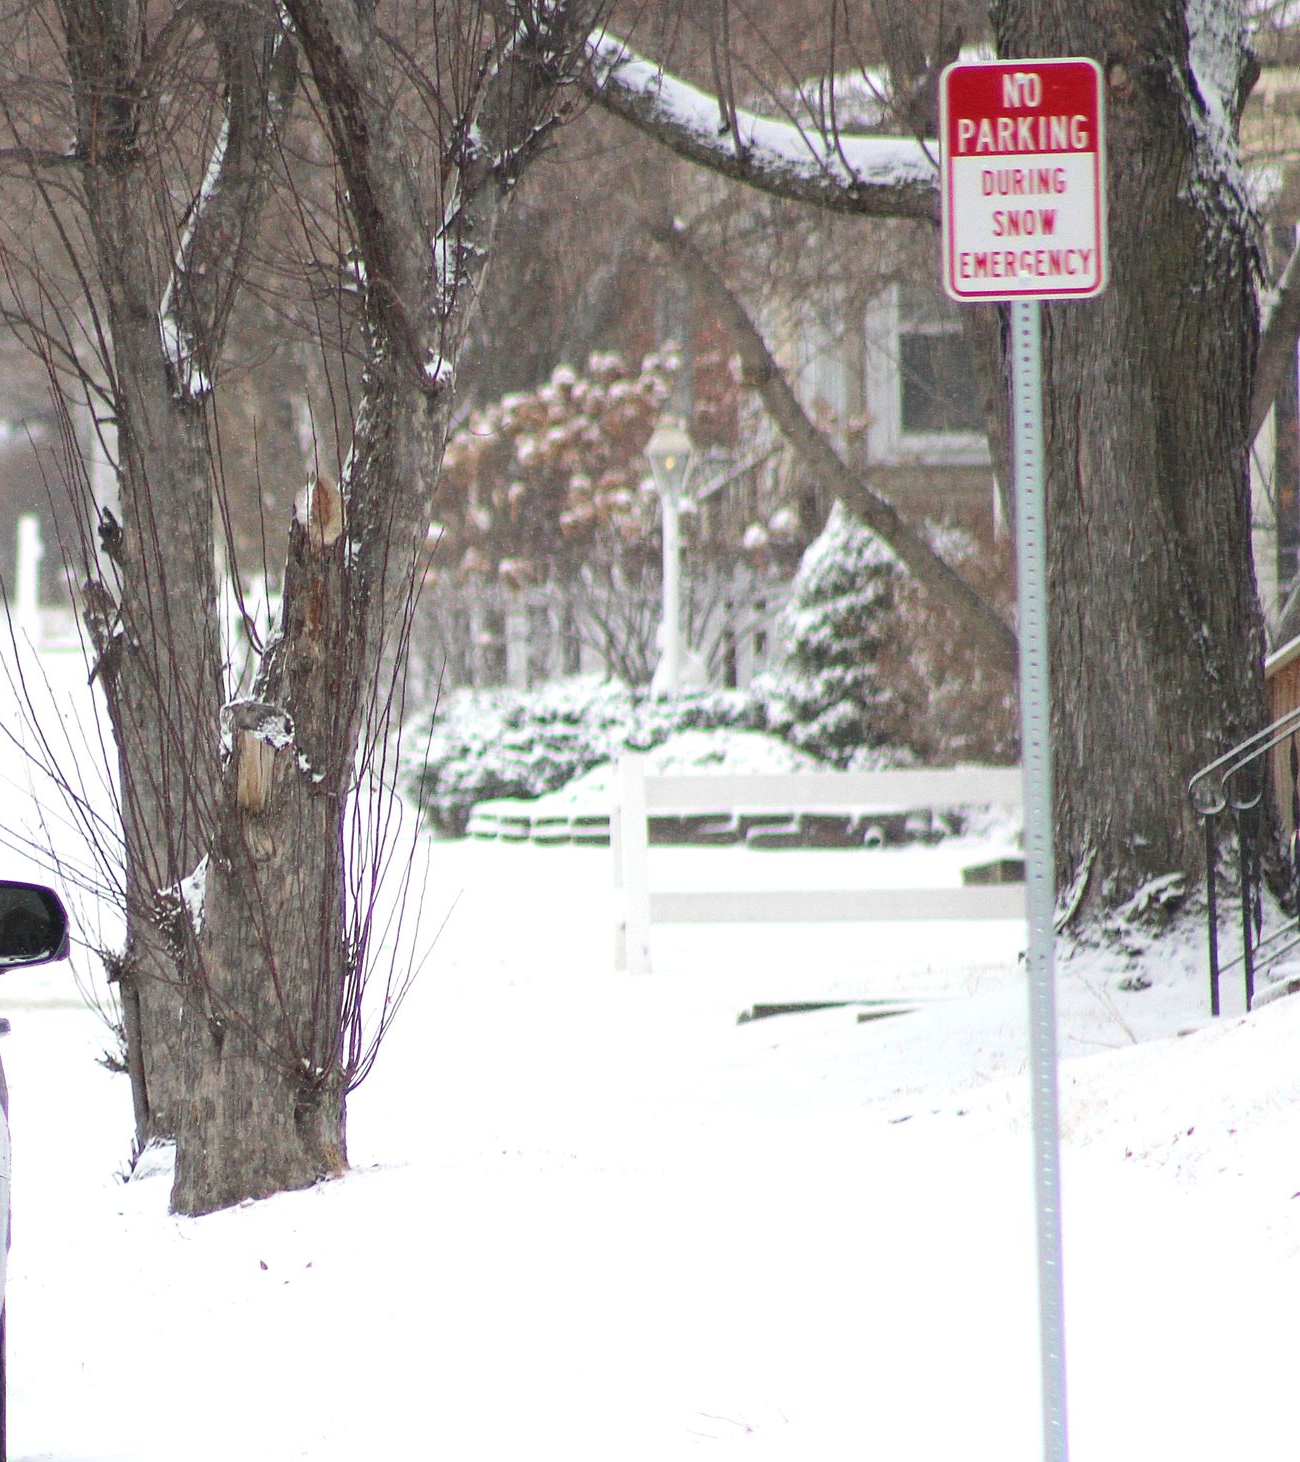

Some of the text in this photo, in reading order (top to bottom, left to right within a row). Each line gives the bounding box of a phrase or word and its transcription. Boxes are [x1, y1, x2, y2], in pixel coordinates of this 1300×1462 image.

[1003, 72, 1042, 108] NO
[957, 114, 1090, 153] PARKING
[981, 167, 1067, 196] DURING
[992, 209, 1058, 237] SNOW
[960, 249, 1092, 279] EMERGENCY
